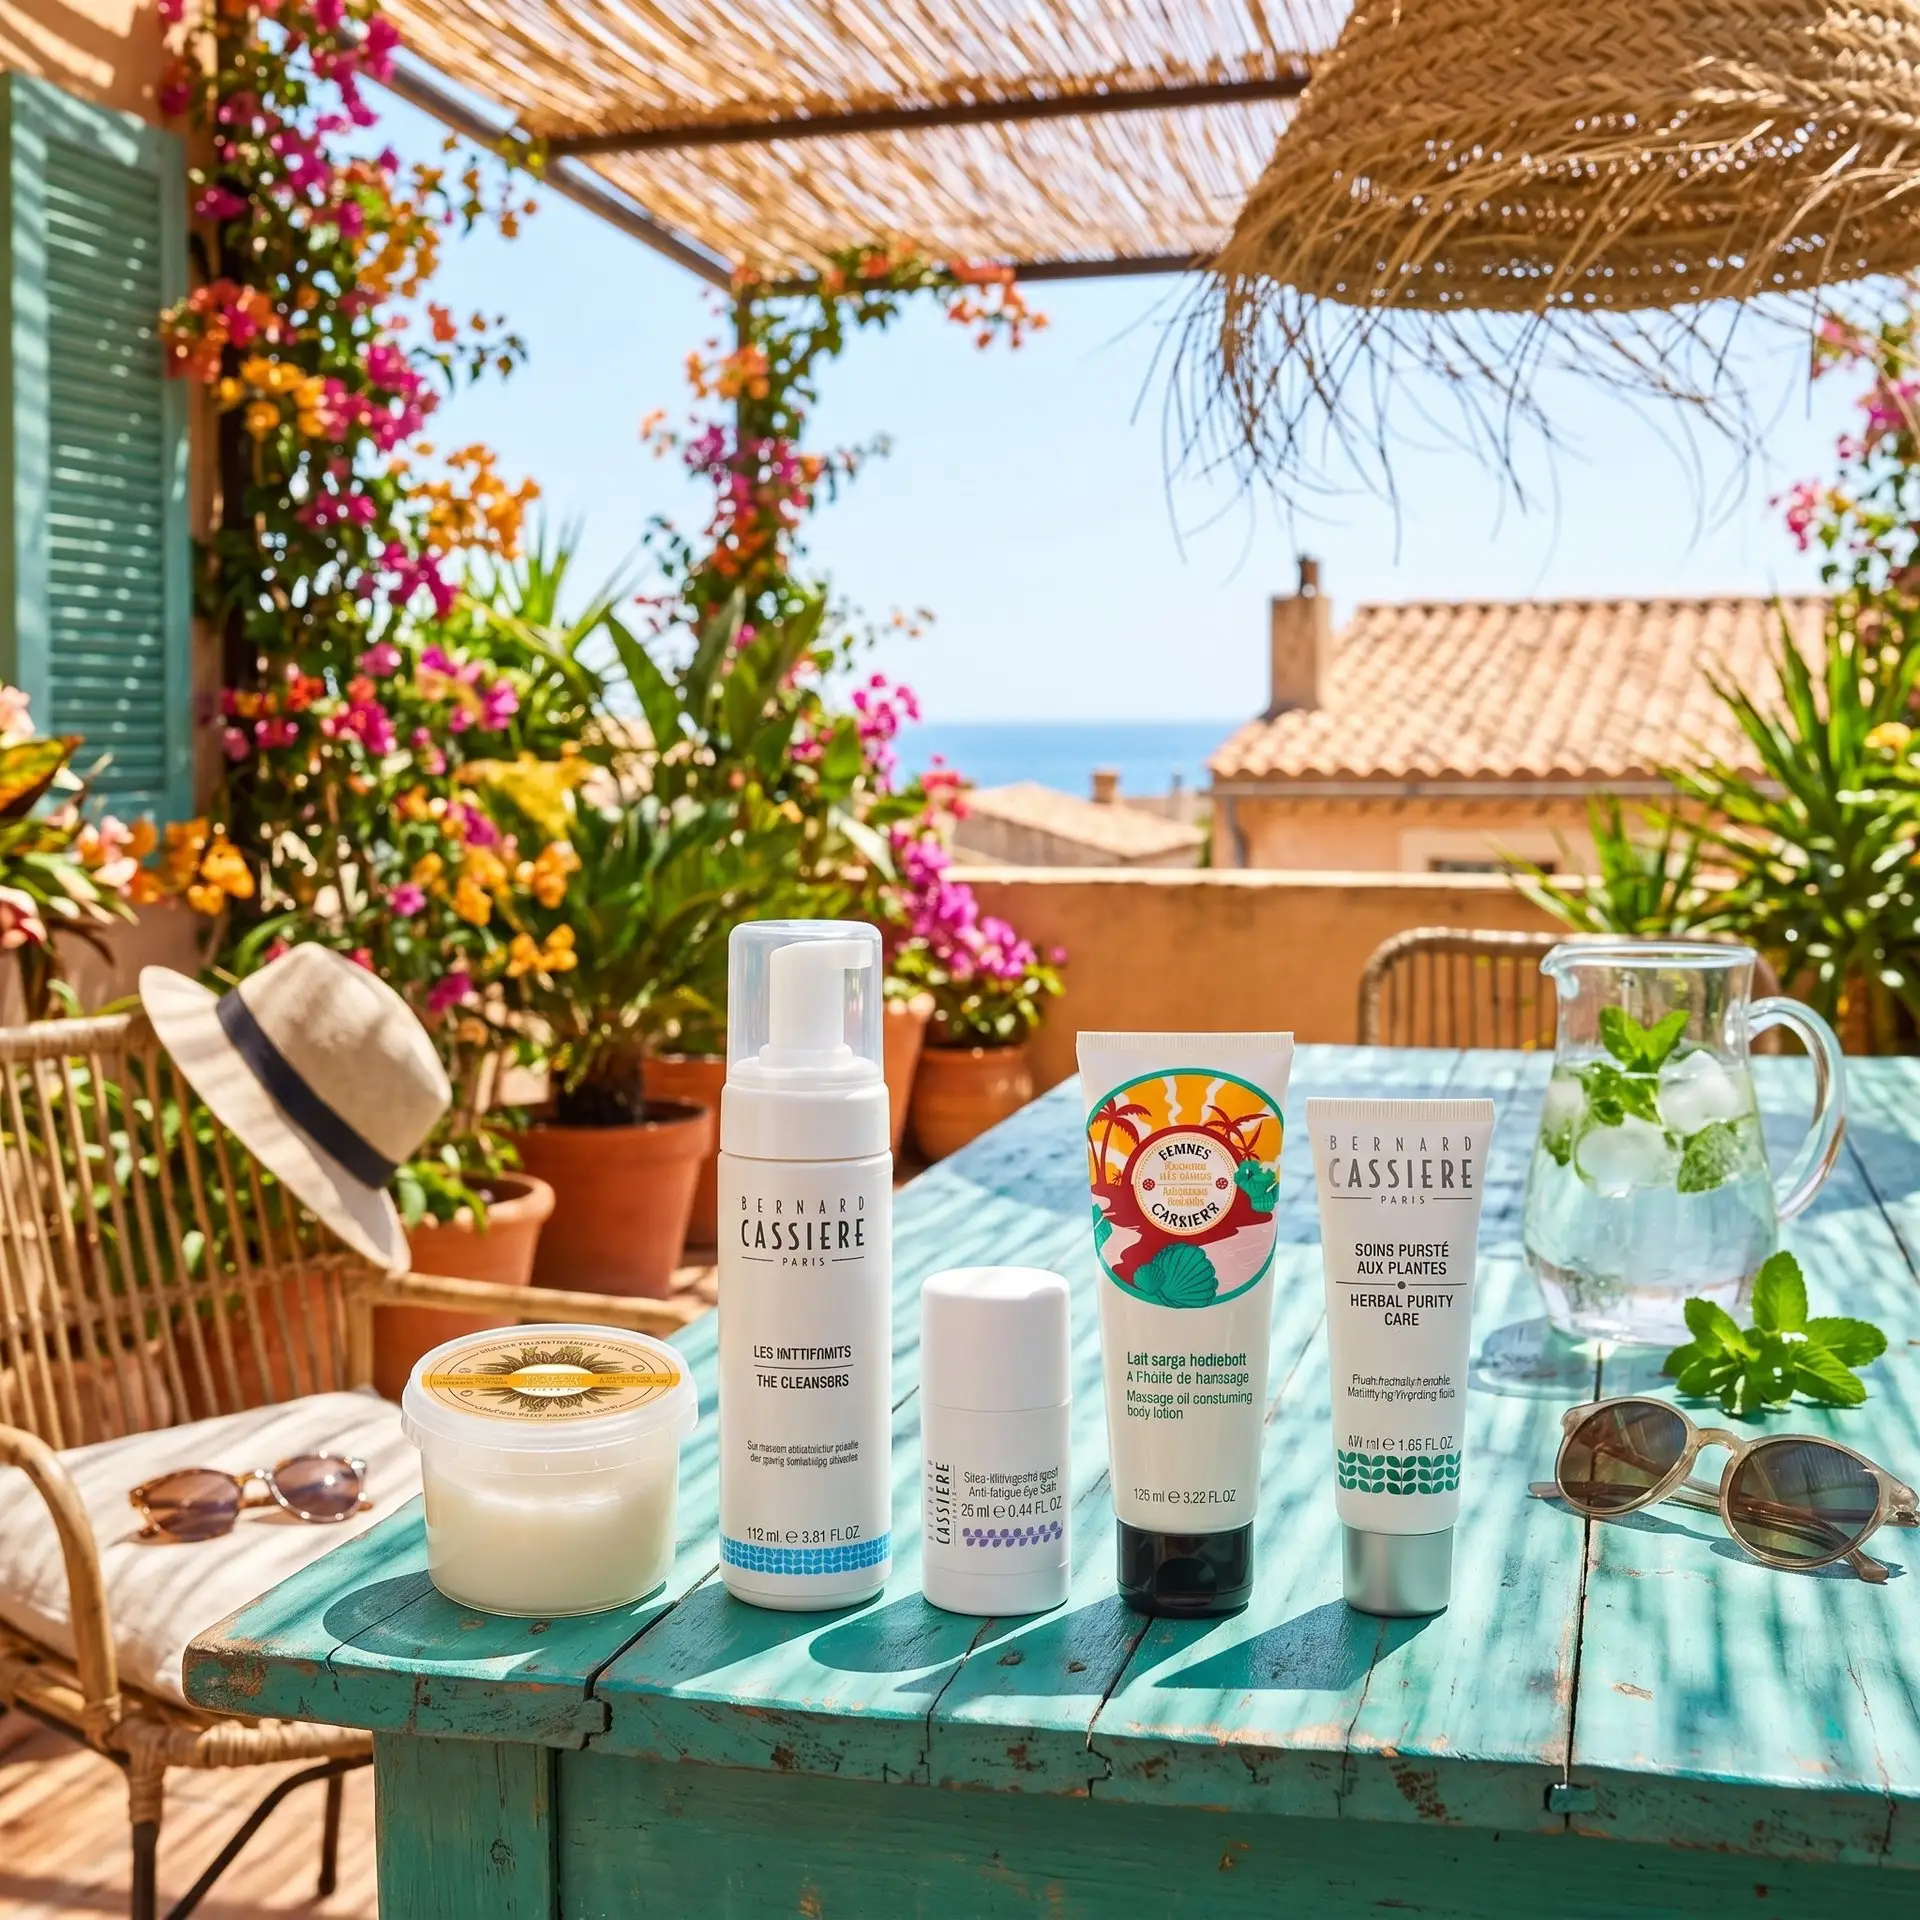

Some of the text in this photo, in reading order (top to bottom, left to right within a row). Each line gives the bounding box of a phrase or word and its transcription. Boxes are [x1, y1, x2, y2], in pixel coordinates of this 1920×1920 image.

[1330, 1135, 1472, 1152] BERNARD
[1328, 1157, 1473, 1189] CASSIERE
[741, 1196, 864, 1214] BERNARD
[1380, 1195, 1425, 1204] PARIS
[741, 1218, 864, 1251] CASSIERE
[1355, 1241, 1449, 1257] SOINS PURSTÉ
[782, 1257, 825, 1267] PARIS
[1357, 1261, 1447, 1275] AUX PLANTES
[1350, 1293, 1454, 1308] HERBAL PURITY
[1384, 1312, 1420, 1326] CARE
[754, 1345, 774, 1359] LES
[1127, 1351, 1148, 1366] Lait
[1151, 1355, 1186, 1370] sarga
[756, 1374, 778, 1388] THE
[1176, 1372, 1192, 1385] de
[1177, 1392, 1190, 1405] oil
[1192, 1391, 1253, 1405] constuming
[1127, 1404, 1184, 1421] body lotion
[1398, 1438, 1422, 1452] 1.65
[968, 1486, 1022, 1500] Anti-fatigue
[1152, 1490, 1165, 1503] ml
[1183, 1491, 1206, 1504] 3.22
[935, 1462, 950, 1544] CASSIERE
[976, 1505, 990, 1518] ml
[1008, 1503, 1033, 1518] 0.44
[1035, 1500, 1049, 1515] FL
[1049, 1495, 1063, 1511] OZ
[747, 1526, 764, 1541] 112
[801, 1531, 826, 1544] 3.81
